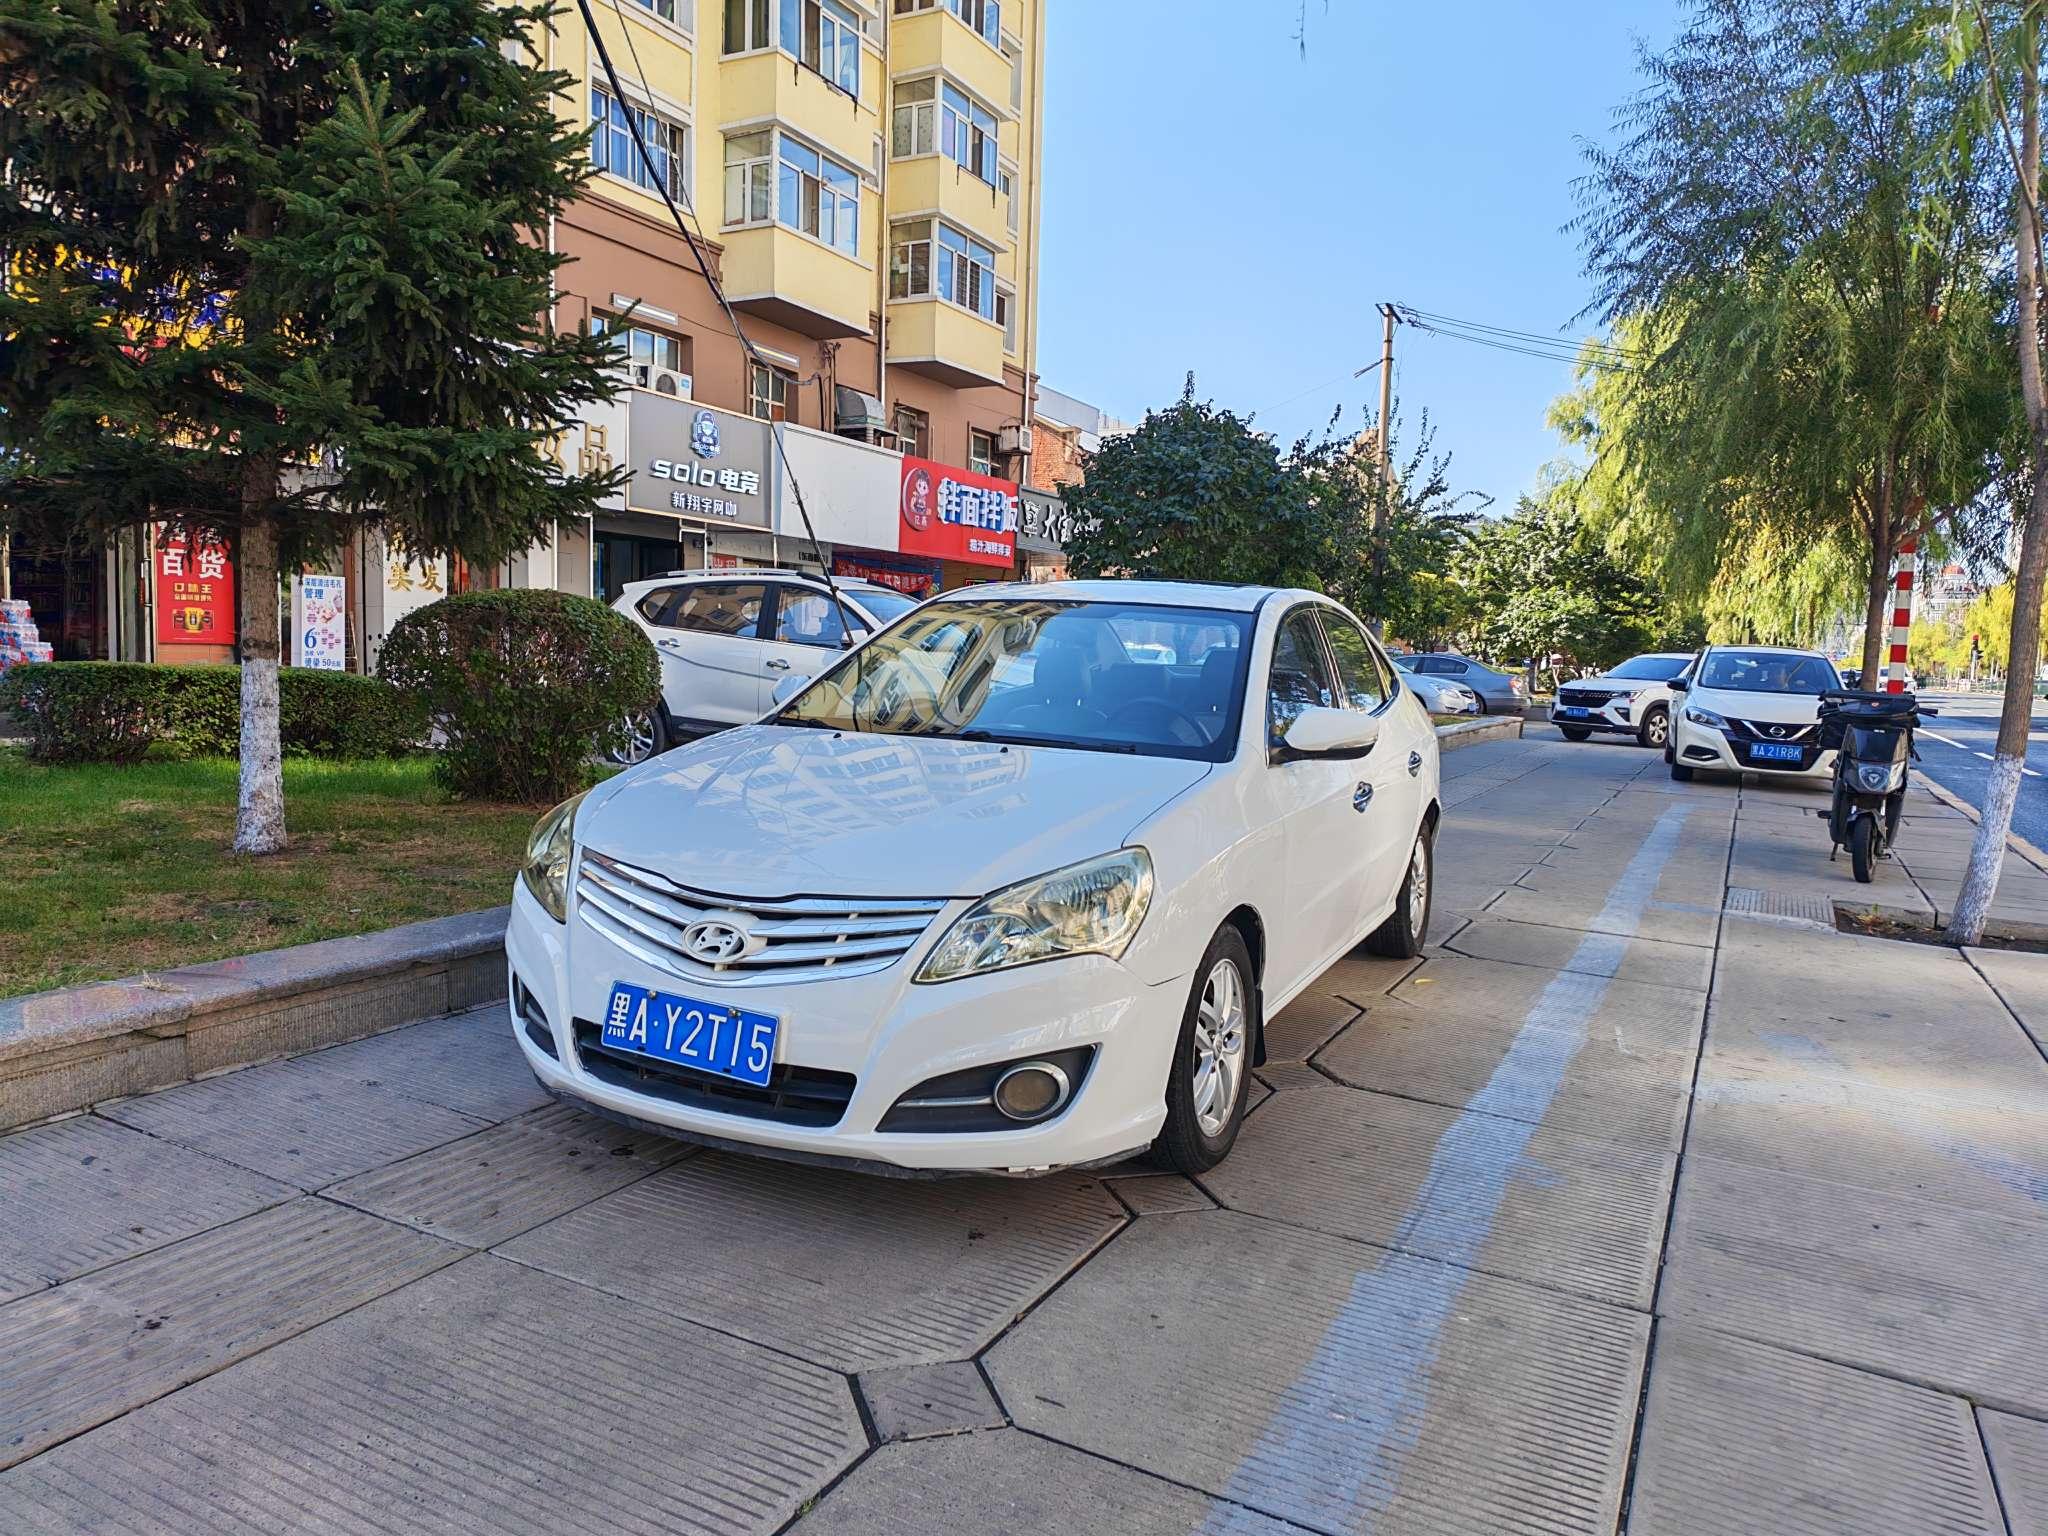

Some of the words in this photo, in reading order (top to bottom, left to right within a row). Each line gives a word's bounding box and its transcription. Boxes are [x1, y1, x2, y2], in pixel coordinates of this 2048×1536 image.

[671, 491, 737, 516] 新翔宇网咖
[162, 548, 226, 579] 百货
[304, 627, 317, 648] 6
